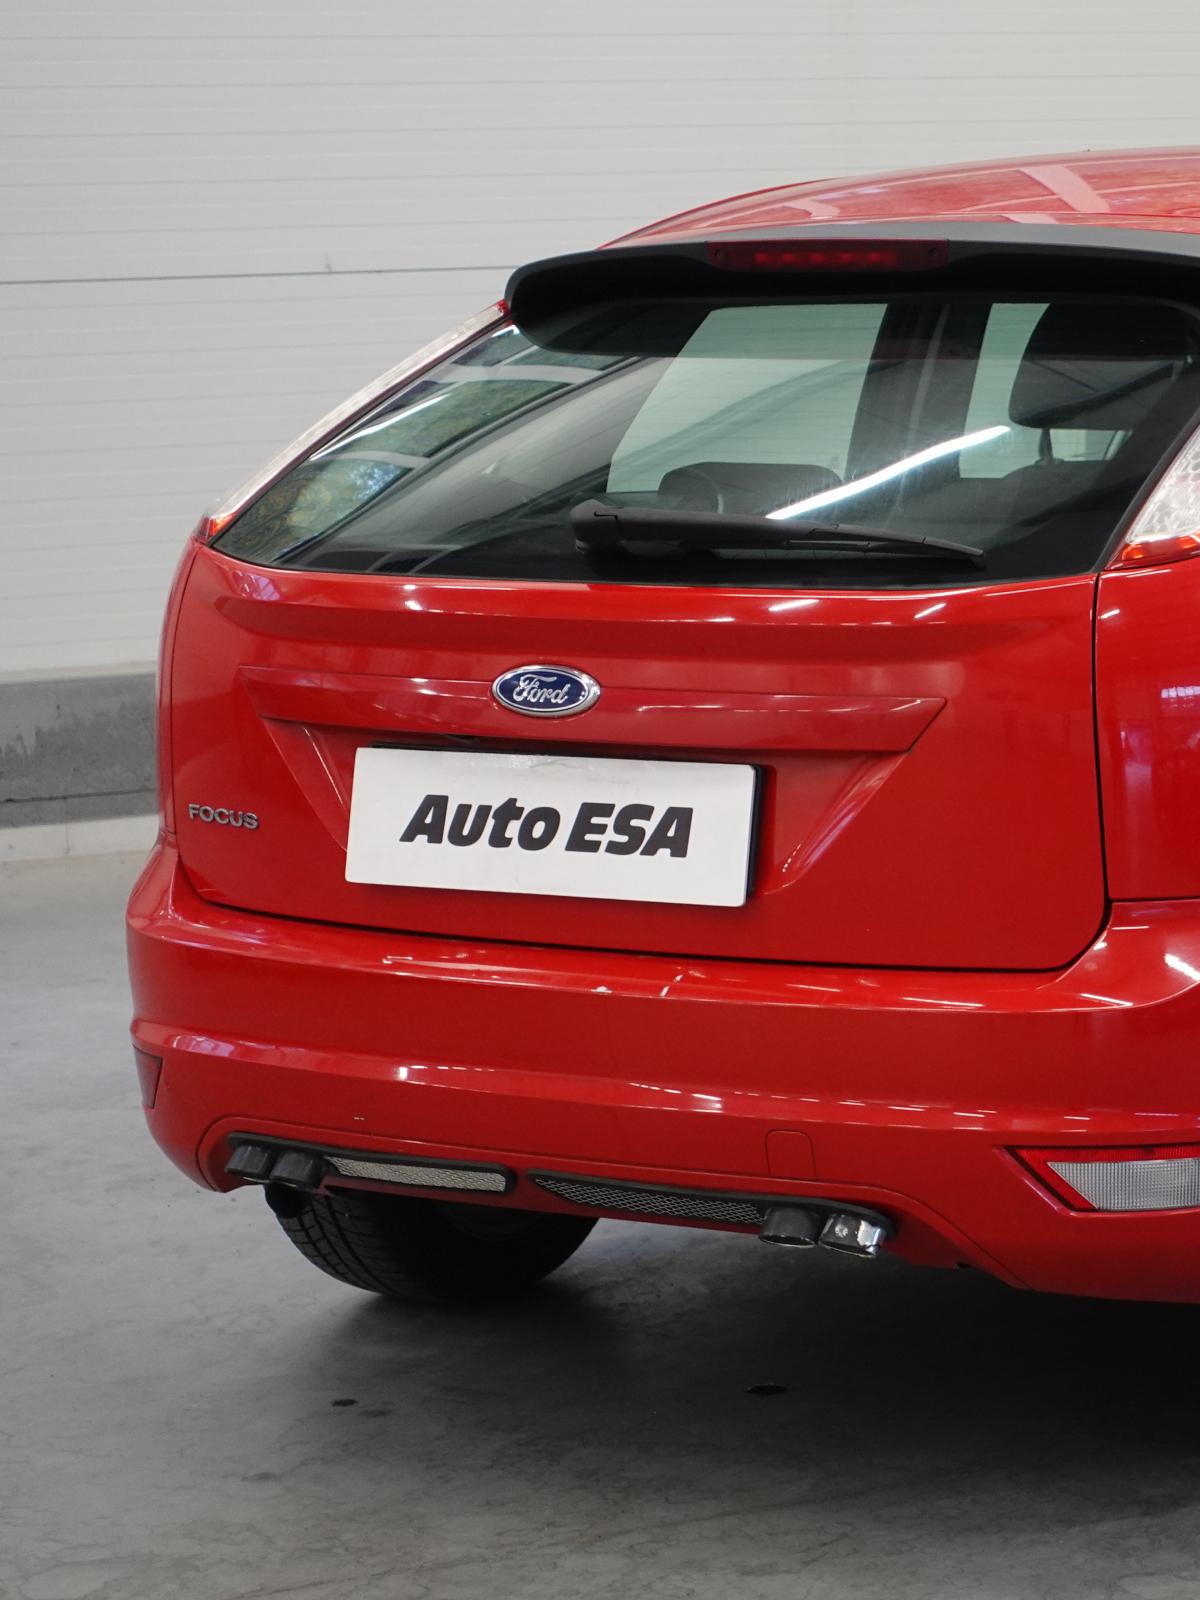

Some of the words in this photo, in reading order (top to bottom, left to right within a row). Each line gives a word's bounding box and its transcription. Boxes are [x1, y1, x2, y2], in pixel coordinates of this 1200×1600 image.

[513, 673, 571, 704] Ford
[188, 803, 259, 830] FOCUS
[399, 794, 561, 851] Auto
[564, 802, 694, 858] ESA
